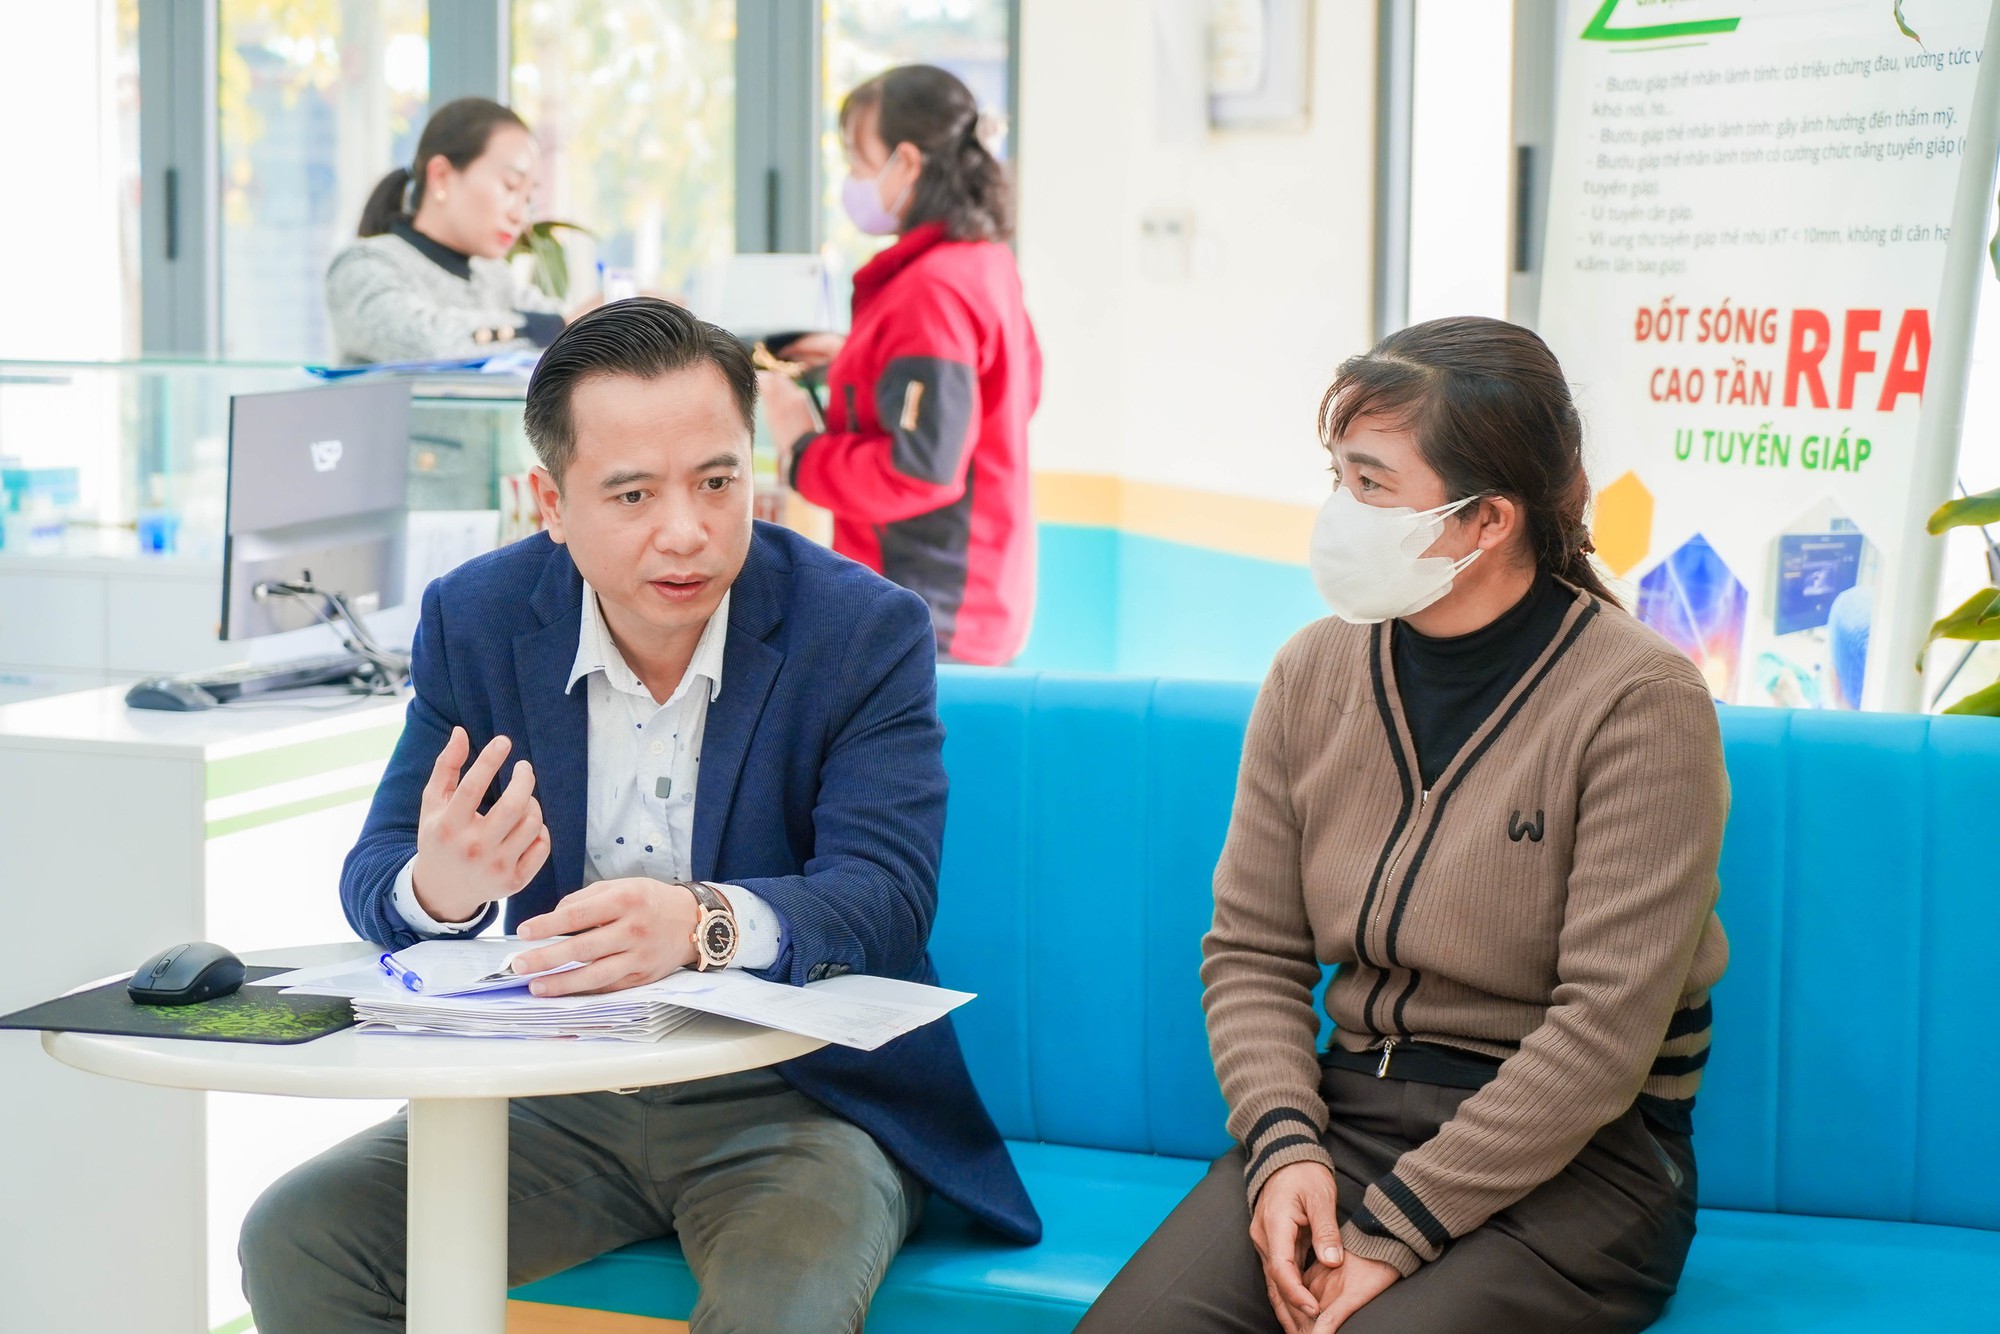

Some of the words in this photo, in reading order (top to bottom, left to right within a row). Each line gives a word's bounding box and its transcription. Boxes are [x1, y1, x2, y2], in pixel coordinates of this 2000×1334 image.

[1801, 63, 1830, 80] triệu
[1875, 55, 1900, 72] đau,
[1949, 47, 1971, 65] tức
[1869, 111, 1892, 129] đến
[1933, 107, 1957, 129] mỹ.
[1887, 137, 1923, 160] tuyến
[1927, 135, 1954, 159] giáp
[1847, 224, 1886, 247] không
[1890, 224, 1902, 242] di
[1906, 224, 1930, 242] căn
[1635, 294, 1690, 342] ĐỐT
[1697, 297, 1777, 344] SÓNG
[1783, 308, 1931, 411] RFA
[1650, 367, 1704, 403] CAO
[1714, 357, 1772, 406] TẦN
[1675, 429, 1693, 461] U
[1702, 421, 1791, 467] TUYẾN
[1801, 427, 1871, 472] GIÁP
